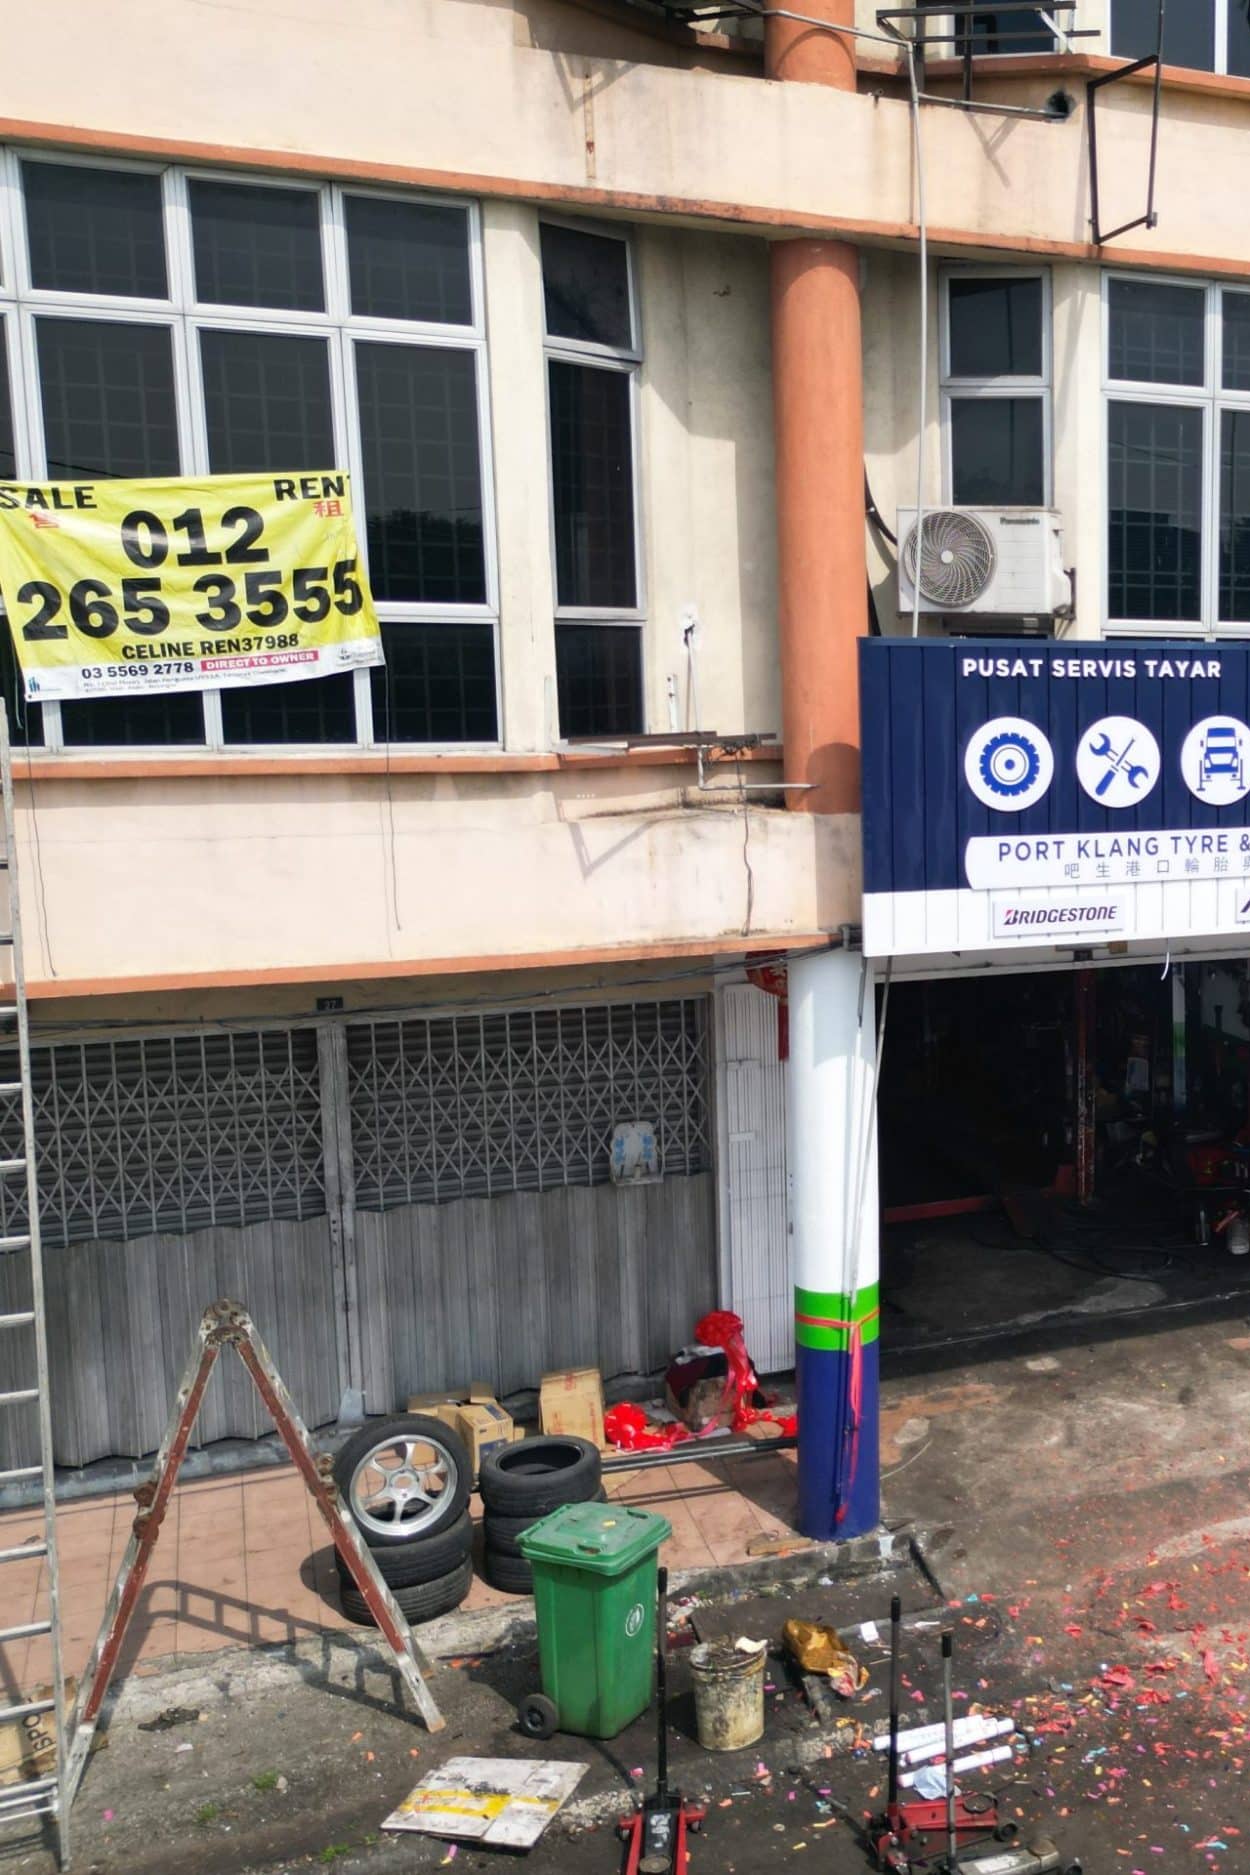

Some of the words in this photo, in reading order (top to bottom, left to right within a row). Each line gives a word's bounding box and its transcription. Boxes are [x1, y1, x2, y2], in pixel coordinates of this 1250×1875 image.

[0, 485, 98, 510] SALE
[273, 475, 350, 501] REN
[313, 500, 345, 518] 租
[121, 506, 269, 569] 012
[17, 577, 171, 641] 265
[192, 559, 364, 632] 3555
[122, 641, 196, 660] CELINE
[200, 633, 299, 656] REN37988
[82, 668, 102, 679] 03
[107, 665, 149, 678] 5569
[153, 661, 194, 675] 2778
[206, 656, 250, 670] DIRECT
[253, 655, 268, 666] TO
[271, 652, 315, 665] OWNER
[963, 659, 1043, 677] PUSAT
[1052, 659, 1136, 677] SERVIS
[1145, 660, 1222, 677] TAYAR
[998, 840, 1065, 862] PORT
[1077, 837, 1159, 858] KLANG
[1170, 834, 1229, 854] TYRE
[1239, 833, 1250, 850] &
[1004, 905, 1117, 925] BRIDGESTONE
